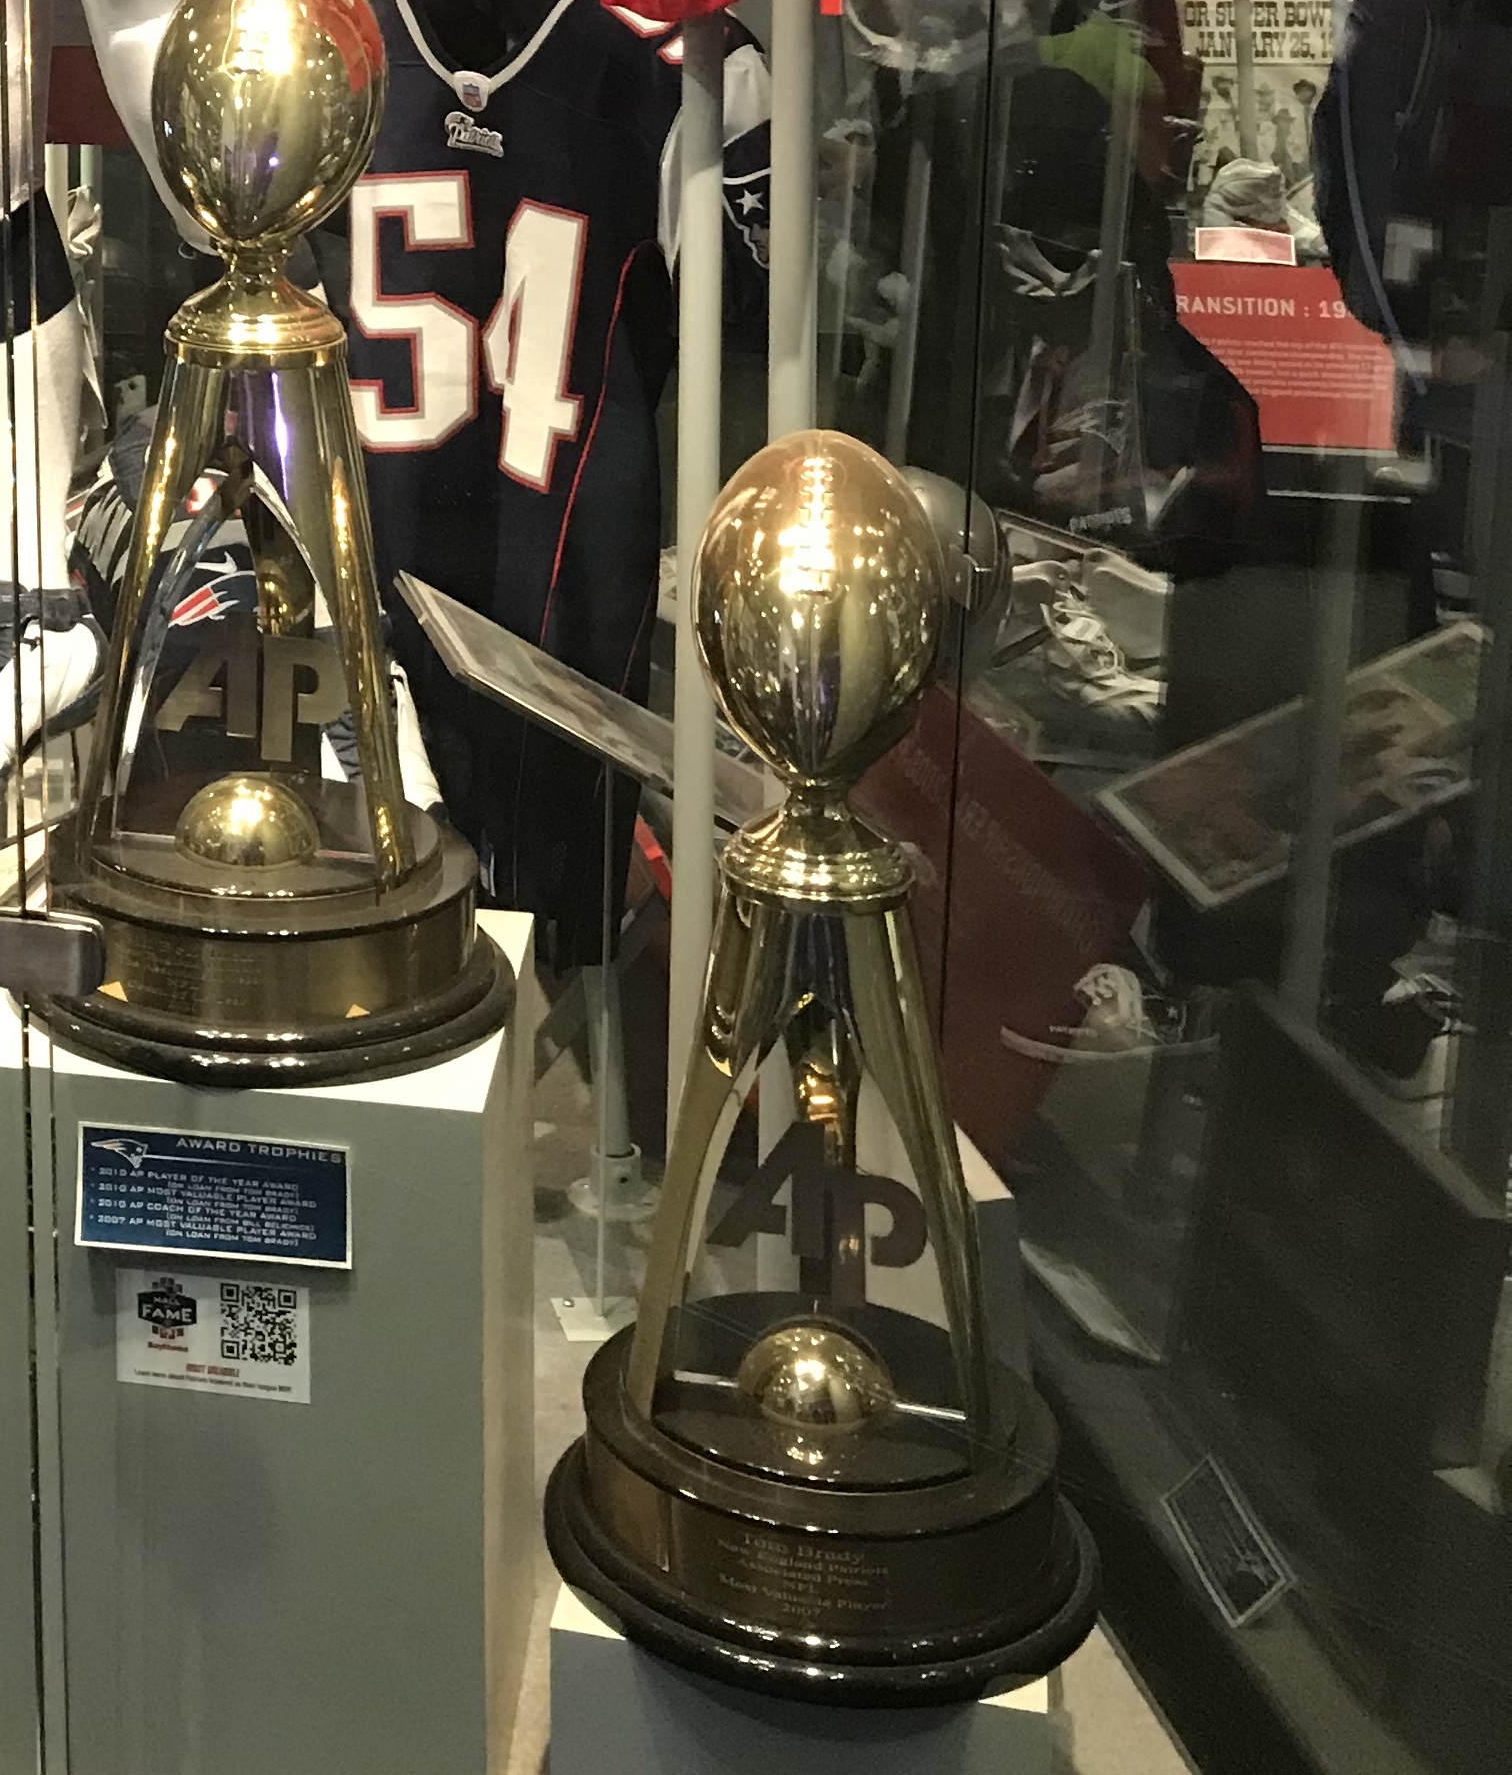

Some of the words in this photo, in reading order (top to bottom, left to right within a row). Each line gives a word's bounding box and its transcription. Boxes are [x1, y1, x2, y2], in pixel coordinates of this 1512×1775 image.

[1197, 31, 1287, 59] JANARY
[1175, 294, 1295, 317] RANSITION
[349, 170, 589, 493] 54
[152, 613, 352, 763] AP
[176, 1137, 241, 1153] AWARD
[248, 1143, 342, 1163] TROPHIES
[148, 1171, 187, 1182] PLAYER
[208, 1176, 228, 1184] THE
[232, 1178, 259, 1186] YEAR
[147, 1203, 184, 1213] COACH
[229, 1210, 257, 1218] YEAR
[706, 1121, 929, 1309] AP
[142, 1303, 192, 1323] FAME
[744, 1533, 789, 1555] Tom
[797, 1545, 865, 1565] Brady
